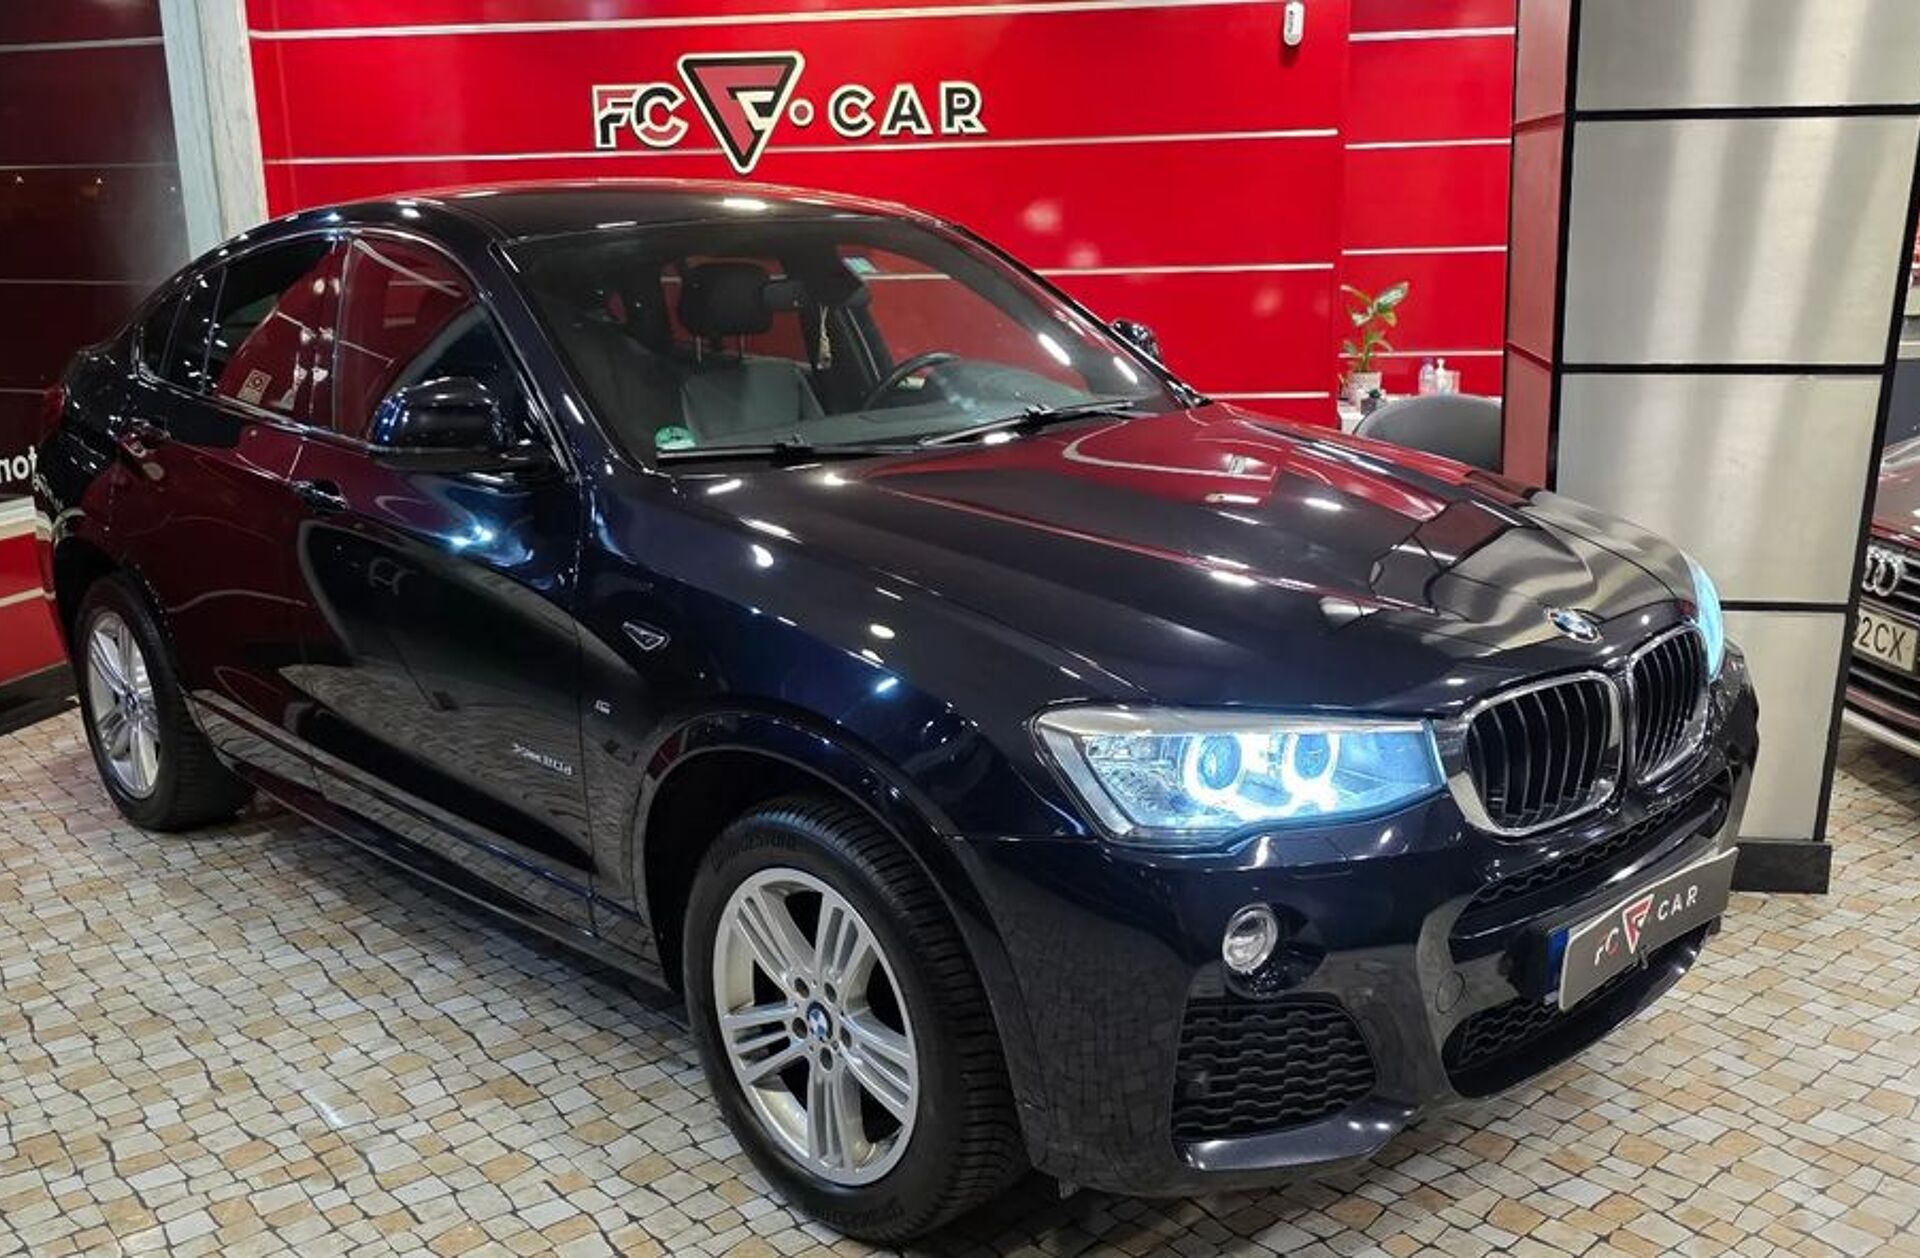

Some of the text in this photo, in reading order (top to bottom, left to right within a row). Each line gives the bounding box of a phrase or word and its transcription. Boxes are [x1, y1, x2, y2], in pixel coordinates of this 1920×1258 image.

[592, 83, 688, 149] FC
[828, 81, 987, 138] CAR
[1657, 885, 1698, 921] CAR
